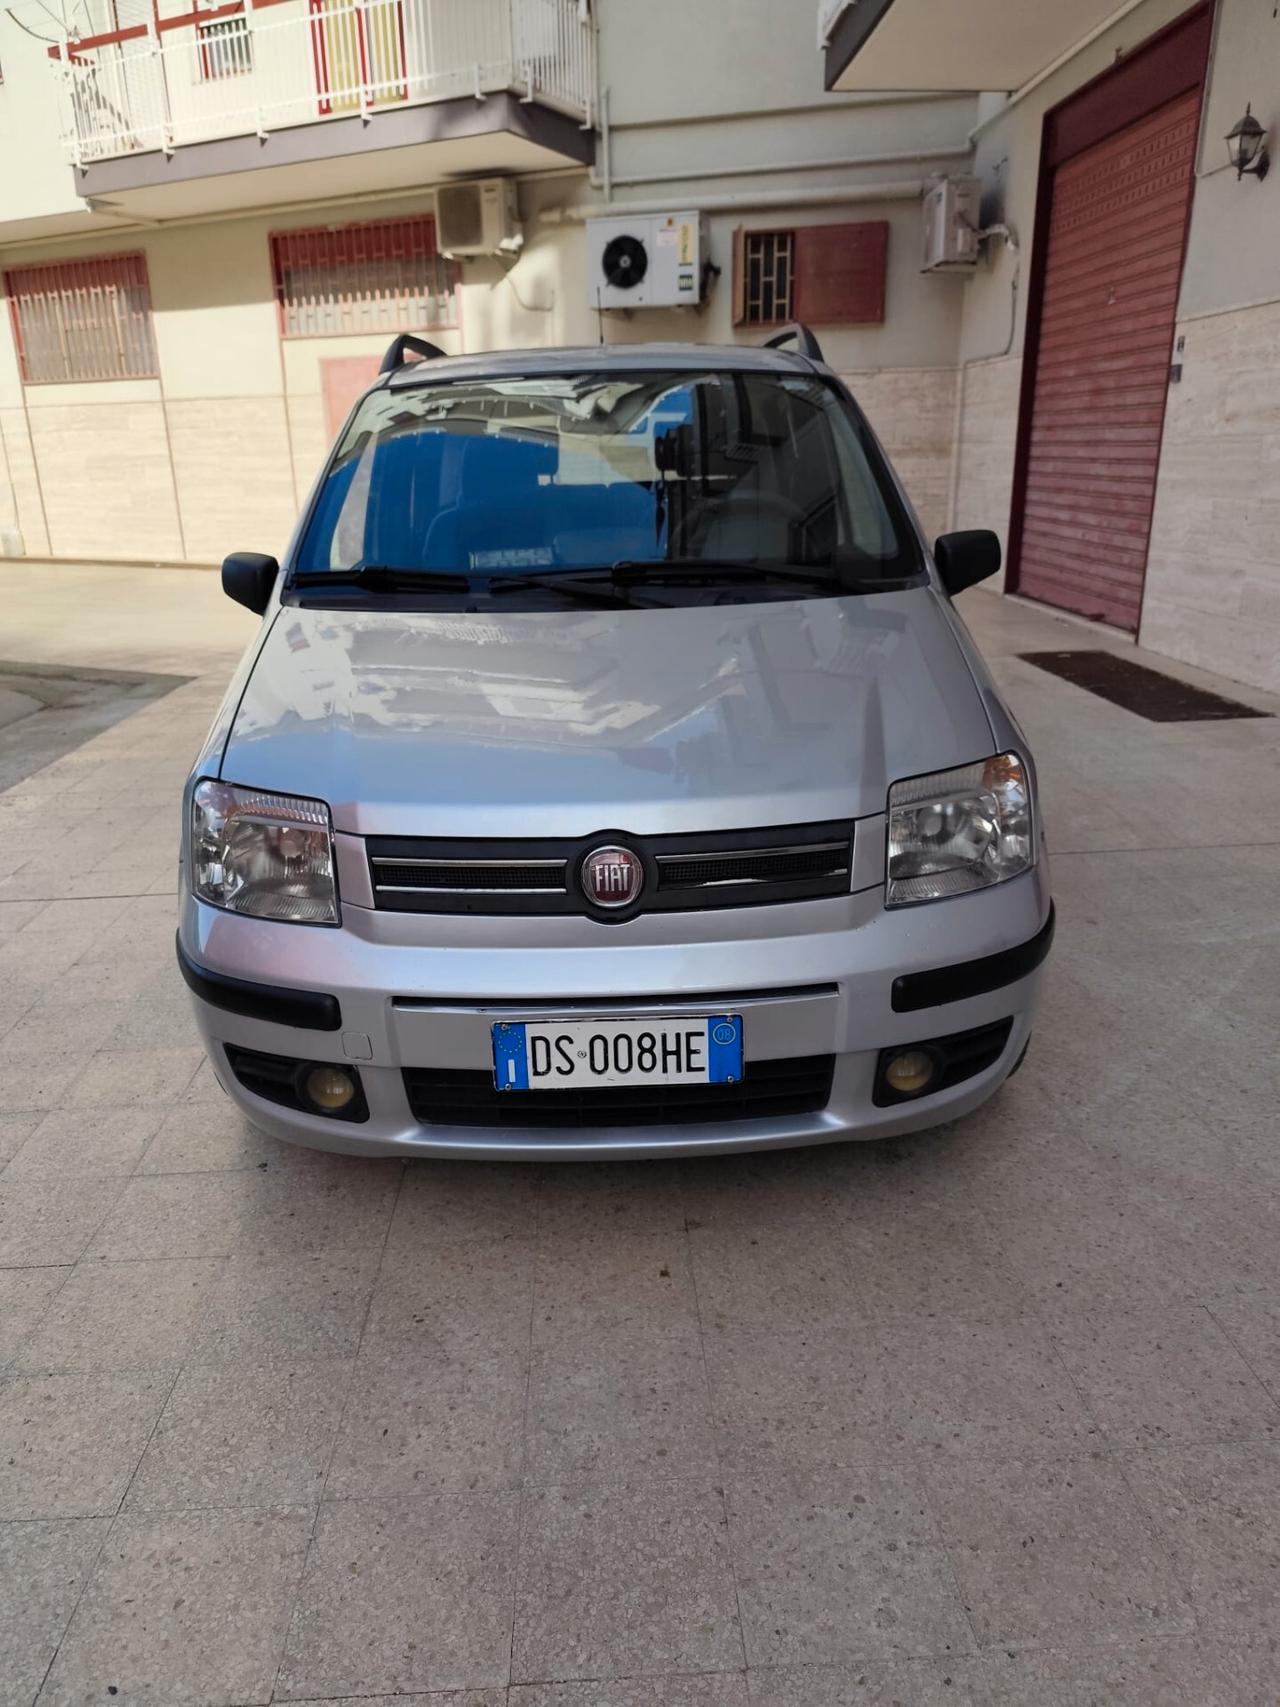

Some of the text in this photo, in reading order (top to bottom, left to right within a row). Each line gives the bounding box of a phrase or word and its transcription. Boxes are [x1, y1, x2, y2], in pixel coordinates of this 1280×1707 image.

[595, 864, 630, 892] FIAT
[717, 1028, 732, 1041] 08
[530, 1031, 706, 1077] DS 008HE
